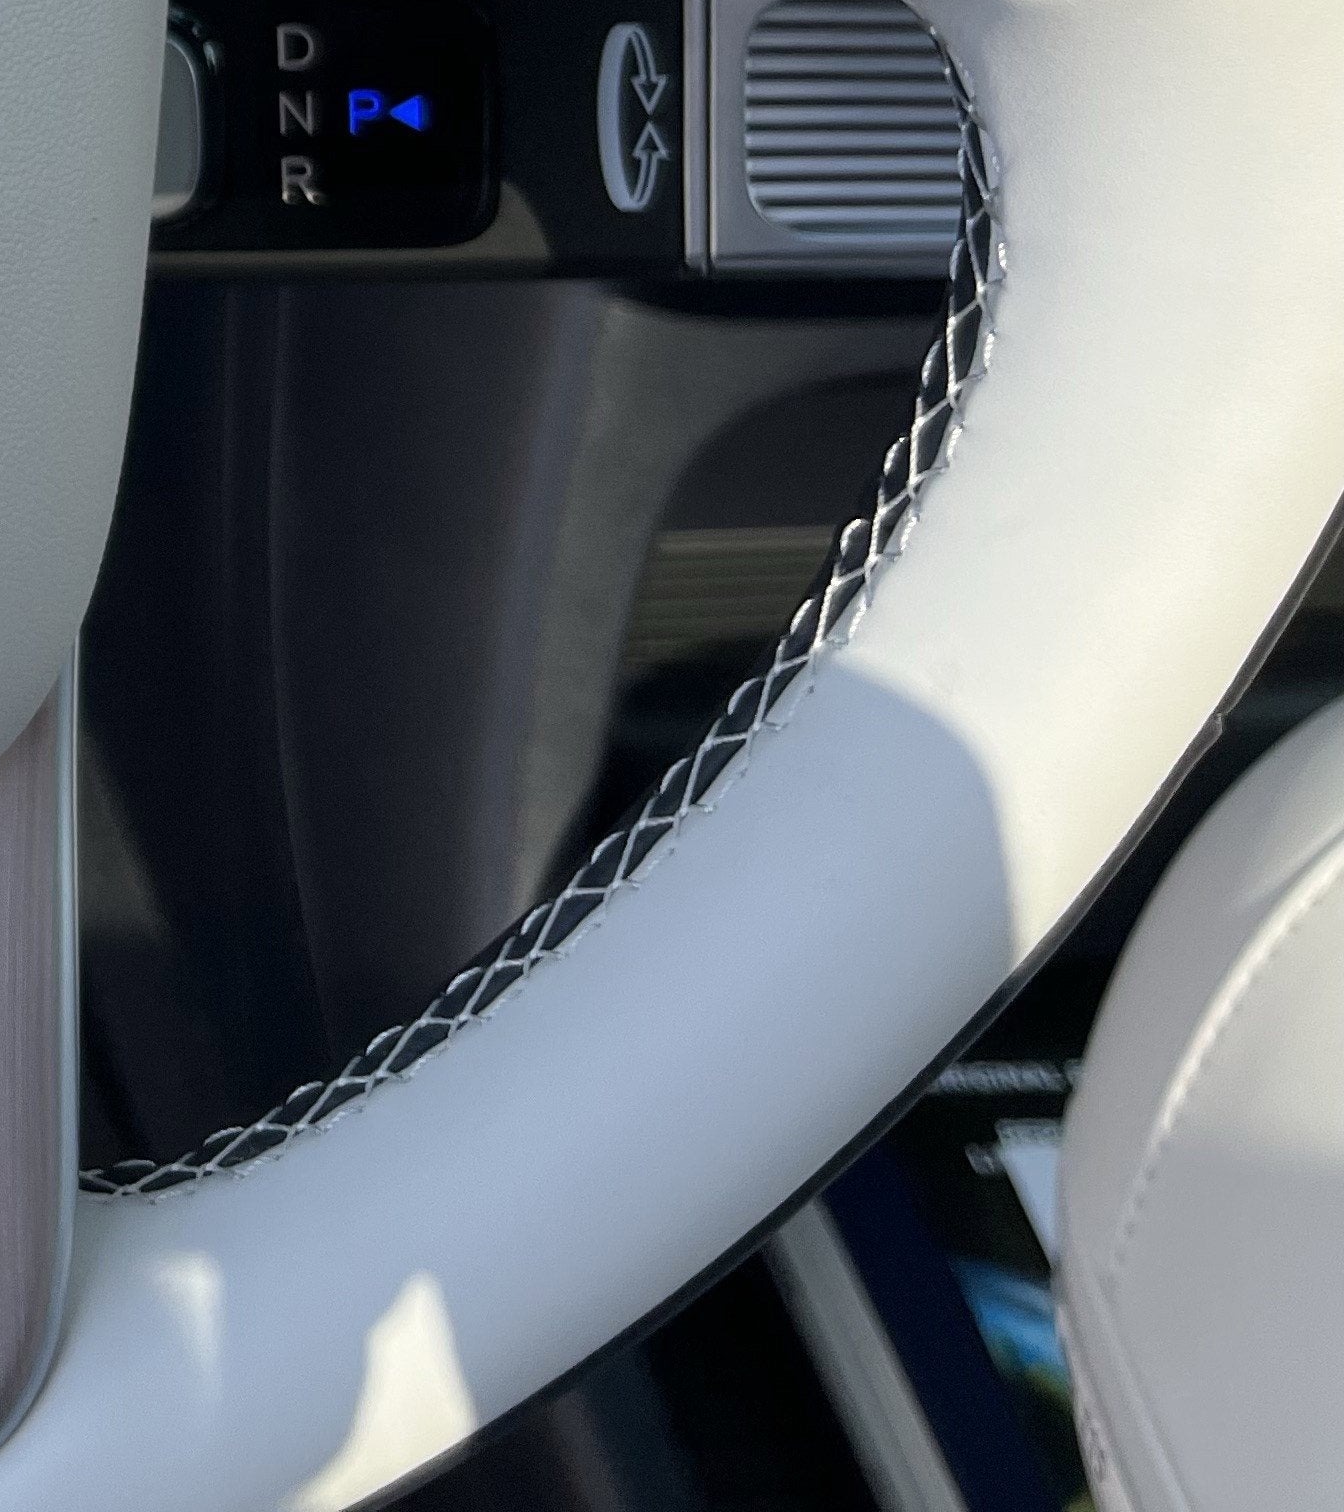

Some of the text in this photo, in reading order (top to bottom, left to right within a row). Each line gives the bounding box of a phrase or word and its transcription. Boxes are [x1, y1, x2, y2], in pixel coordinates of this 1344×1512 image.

[276, 23, 314, 71] D
[278, 90, 315, 136] N
[347, 88, 382, 135] P
[280, 155, 319, 205] R
